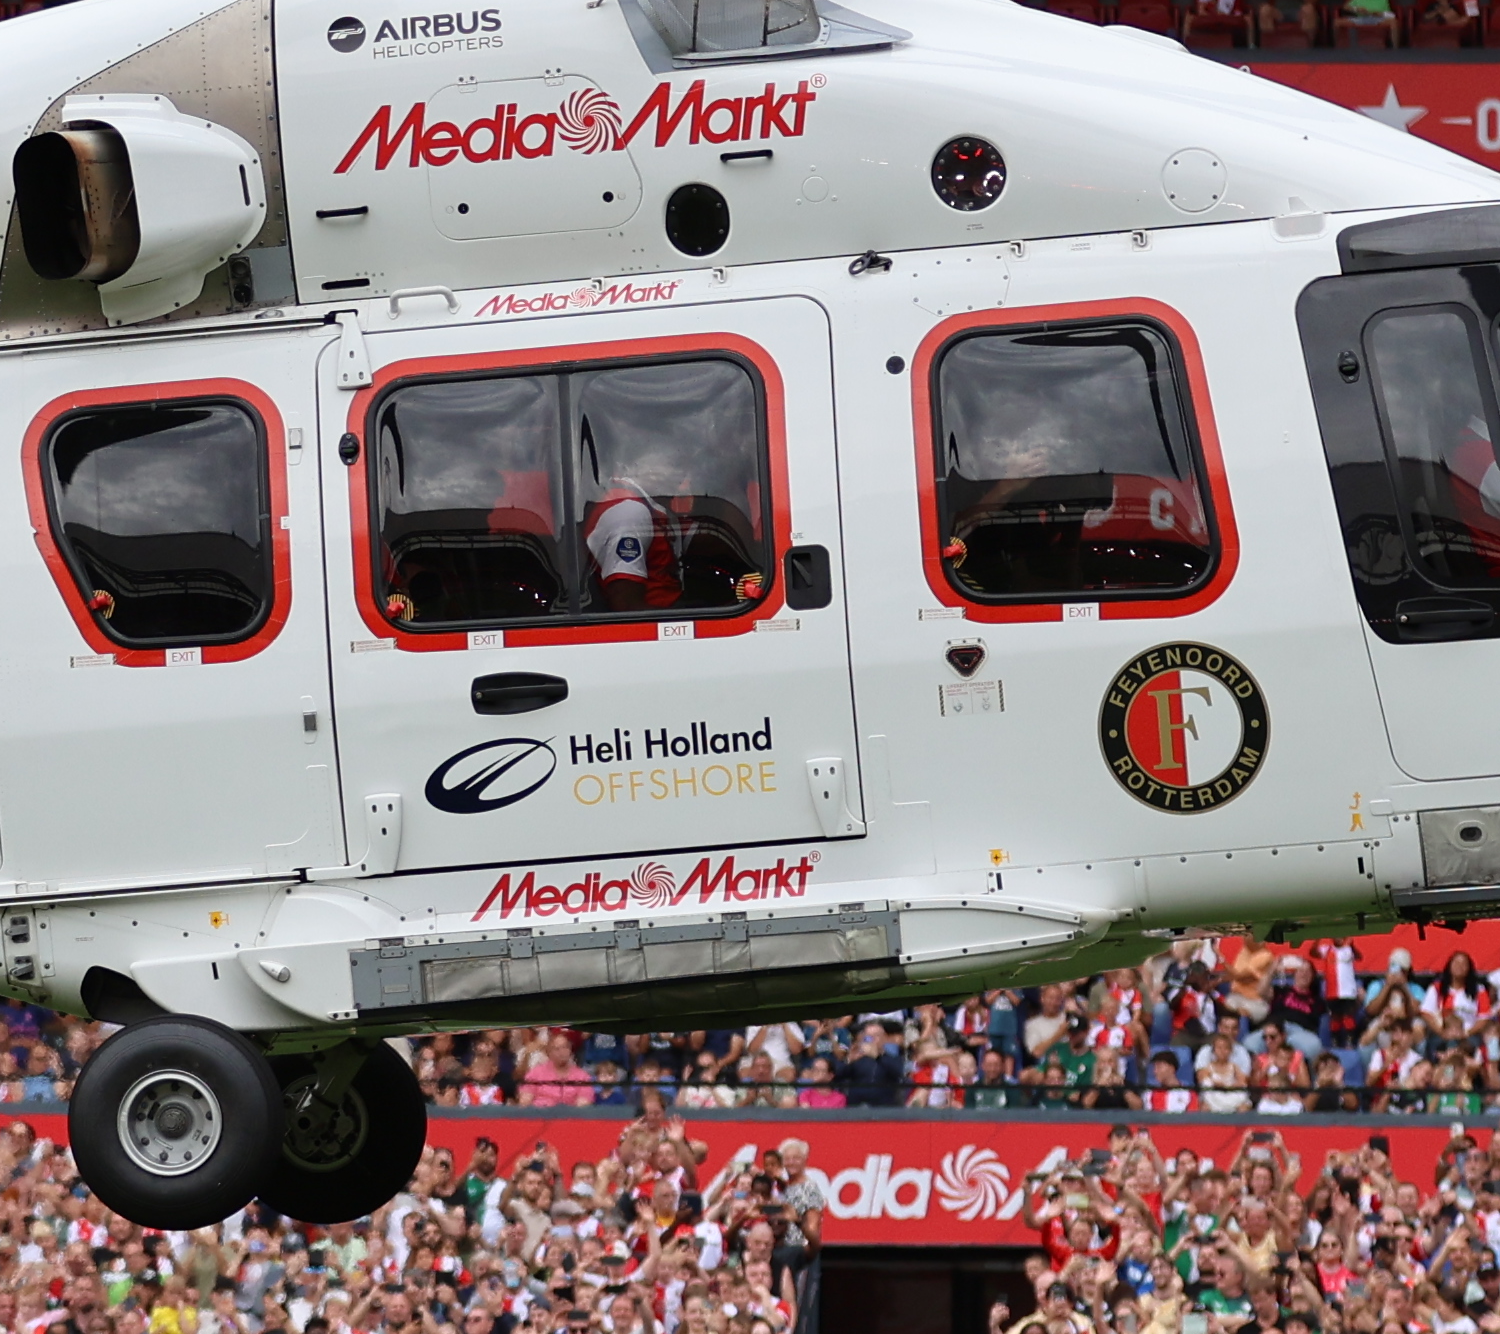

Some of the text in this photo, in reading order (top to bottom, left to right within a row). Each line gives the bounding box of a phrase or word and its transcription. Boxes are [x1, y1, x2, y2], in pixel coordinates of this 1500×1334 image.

[373, 9, 502, 43] AIRBUS
[373, 36, 503, 59] HELICOPTERS
[332, 102, 557, 174] Media
[663, 625, 688, 636] EXIT
[1069, 606, 1093, 618] EXIT
[171, 651, 196, 662] EXIT
[473, 634, 497, 646] EXIT
[1109, 648, 1254, 709] FEYENOORD
[569, 716, 772, 765] Heli Holland
[573, 761, 777, 806] OFFSHORE
[1113, 747, 1260, 808] ROTTERDAM
[470, 871, 630, 923] Media
